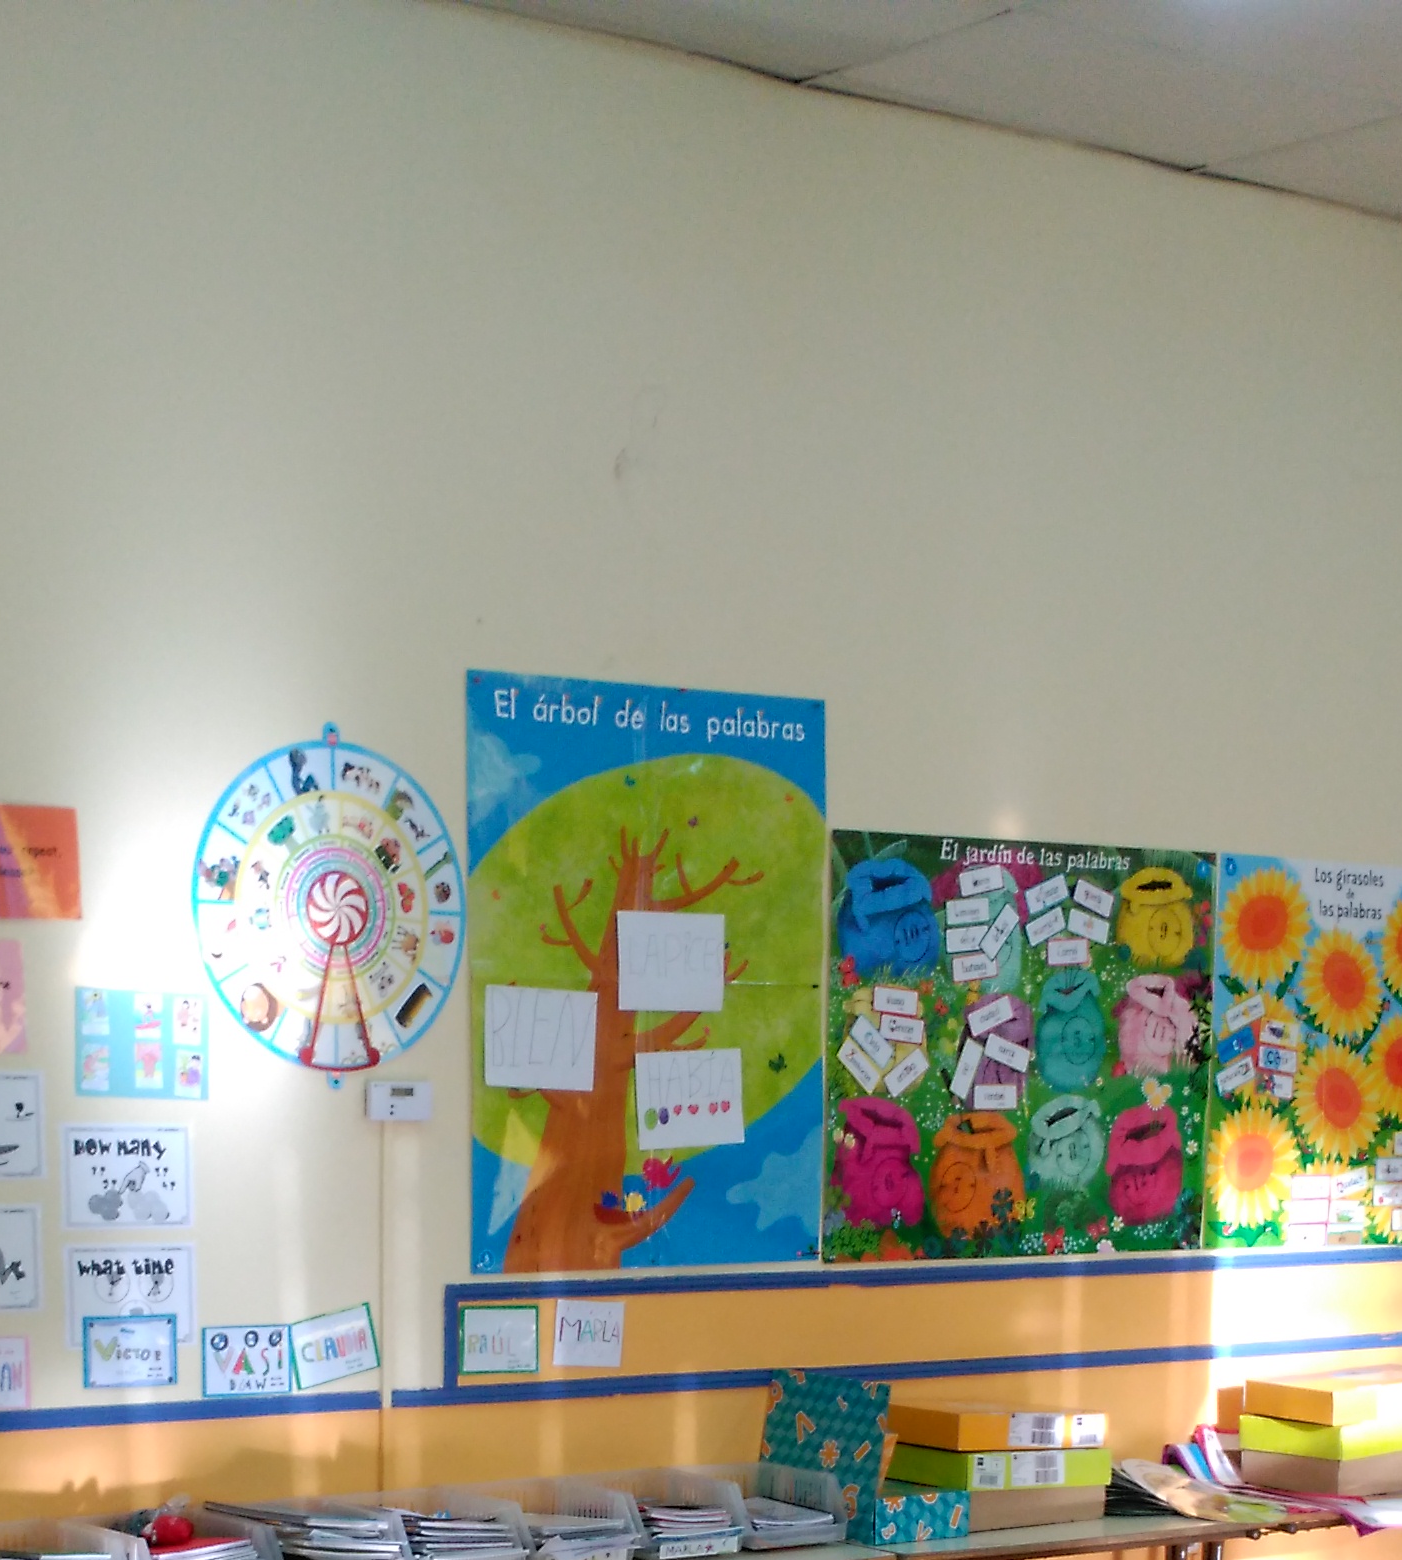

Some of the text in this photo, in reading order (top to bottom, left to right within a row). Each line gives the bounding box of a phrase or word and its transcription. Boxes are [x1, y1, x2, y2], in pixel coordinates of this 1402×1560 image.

[494, 688, 806, 743] El árbol de las palabras
[940, 839, 1131, 873] El jardín de las palabras
[1315, 867, 1384, 891] Los girasoles
[1319, 899, 1382, 923] las palabras
